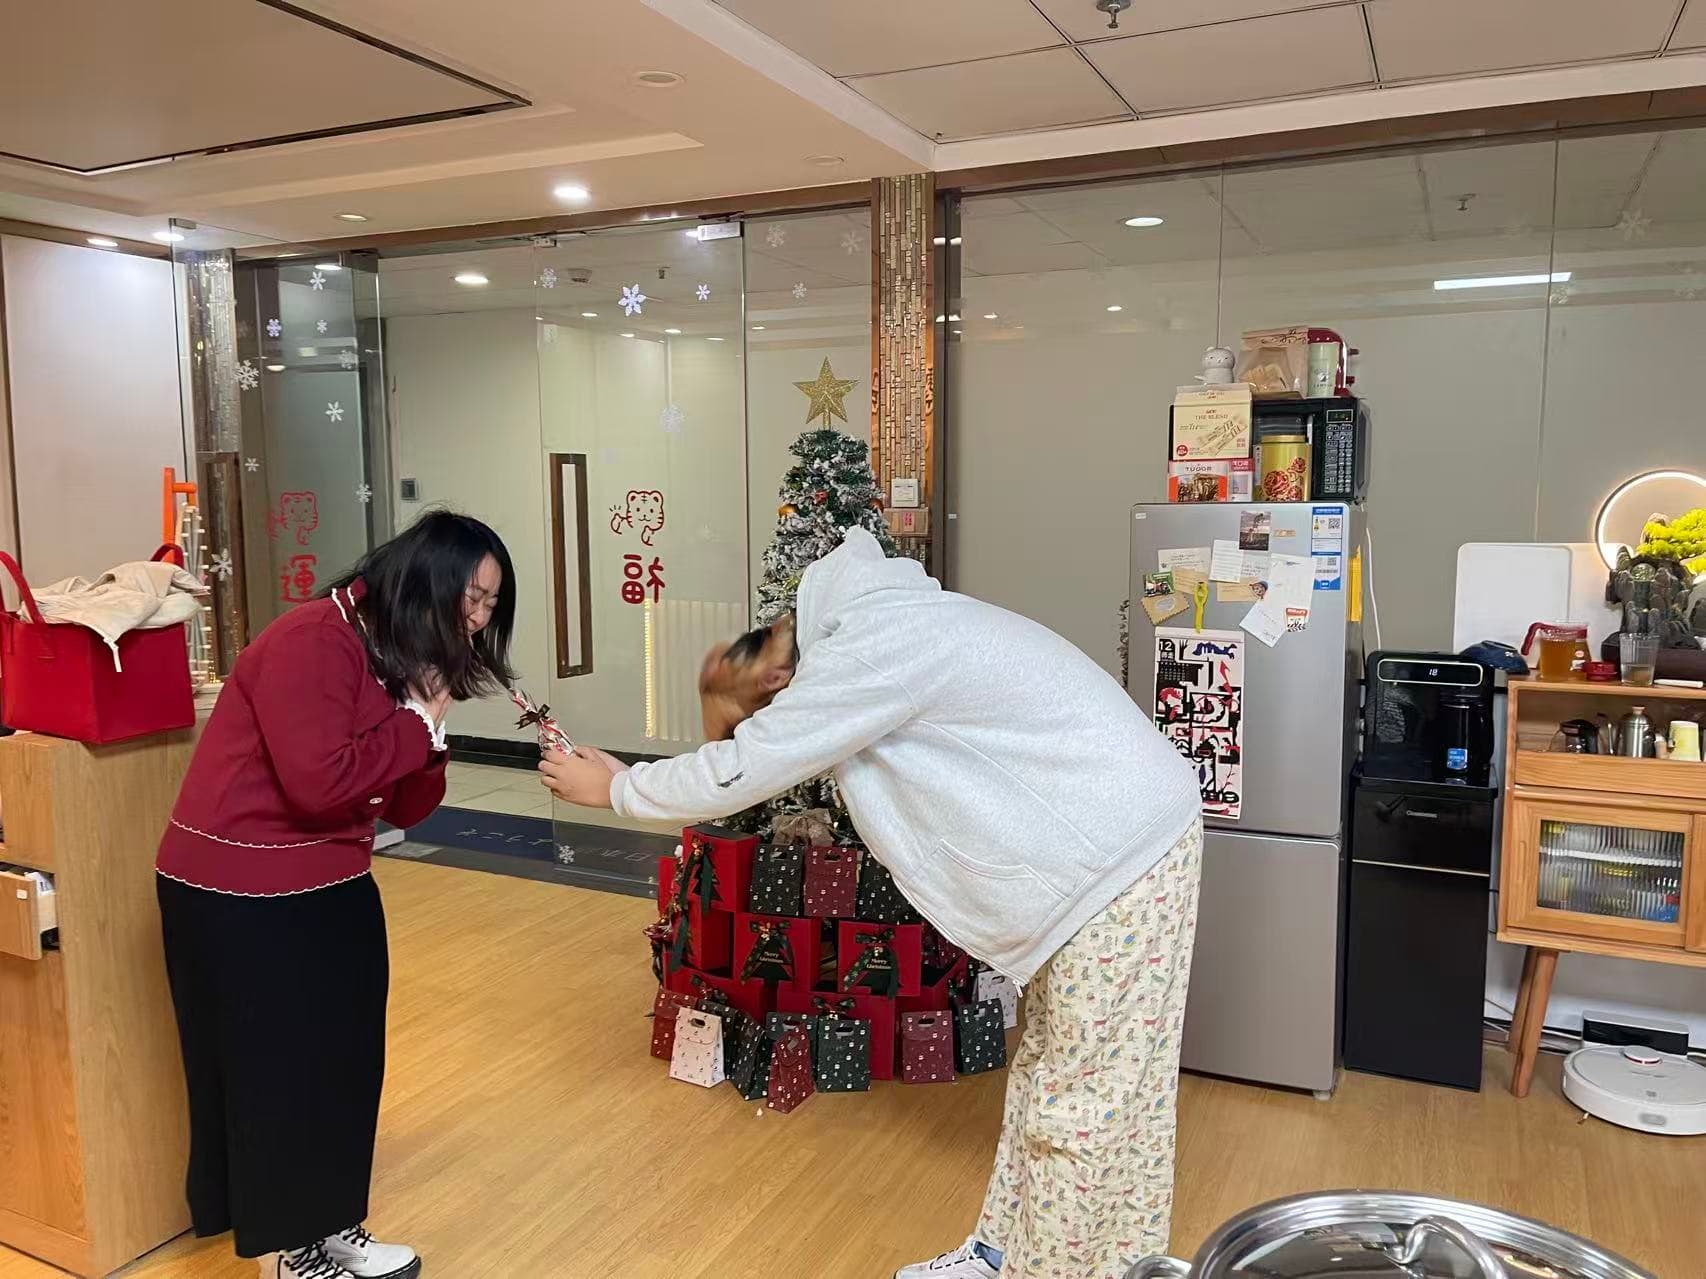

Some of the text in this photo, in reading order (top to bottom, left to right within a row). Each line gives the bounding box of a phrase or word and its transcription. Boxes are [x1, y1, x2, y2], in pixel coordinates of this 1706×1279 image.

[1159, 640, 1173, 651] 12
[1428, 668, 1438, 676] 18
[764, 951, 780, 959] Merry
